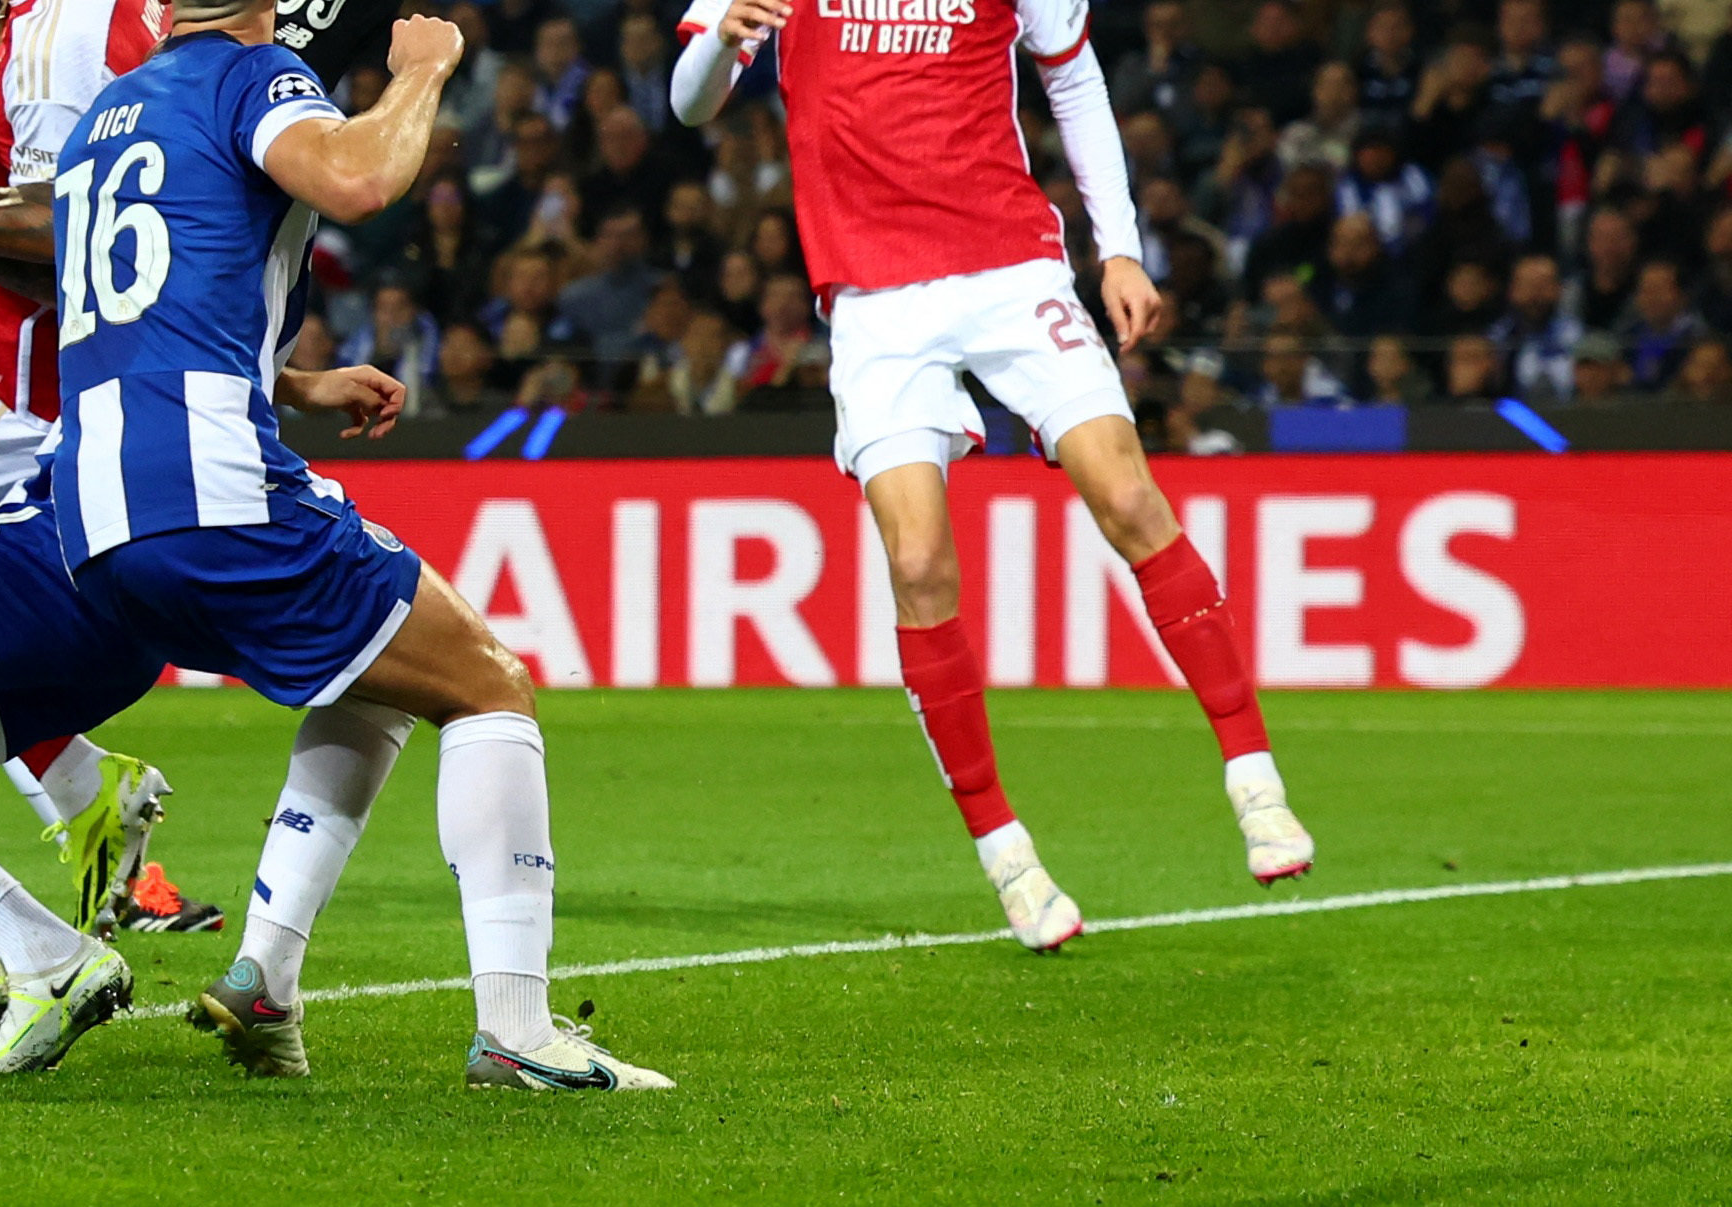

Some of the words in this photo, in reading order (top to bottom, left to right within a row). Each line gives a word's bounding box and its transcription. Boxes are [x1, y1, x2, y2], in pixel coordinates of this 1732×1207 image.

[839, 22, 874, 53] FLY
[876, 23, 954, 55] BETTER
[86, 101, 144, 145] NICO
[54, 140, 172, 351] 16
[448, 492, 1526, 689] AIRLINES
